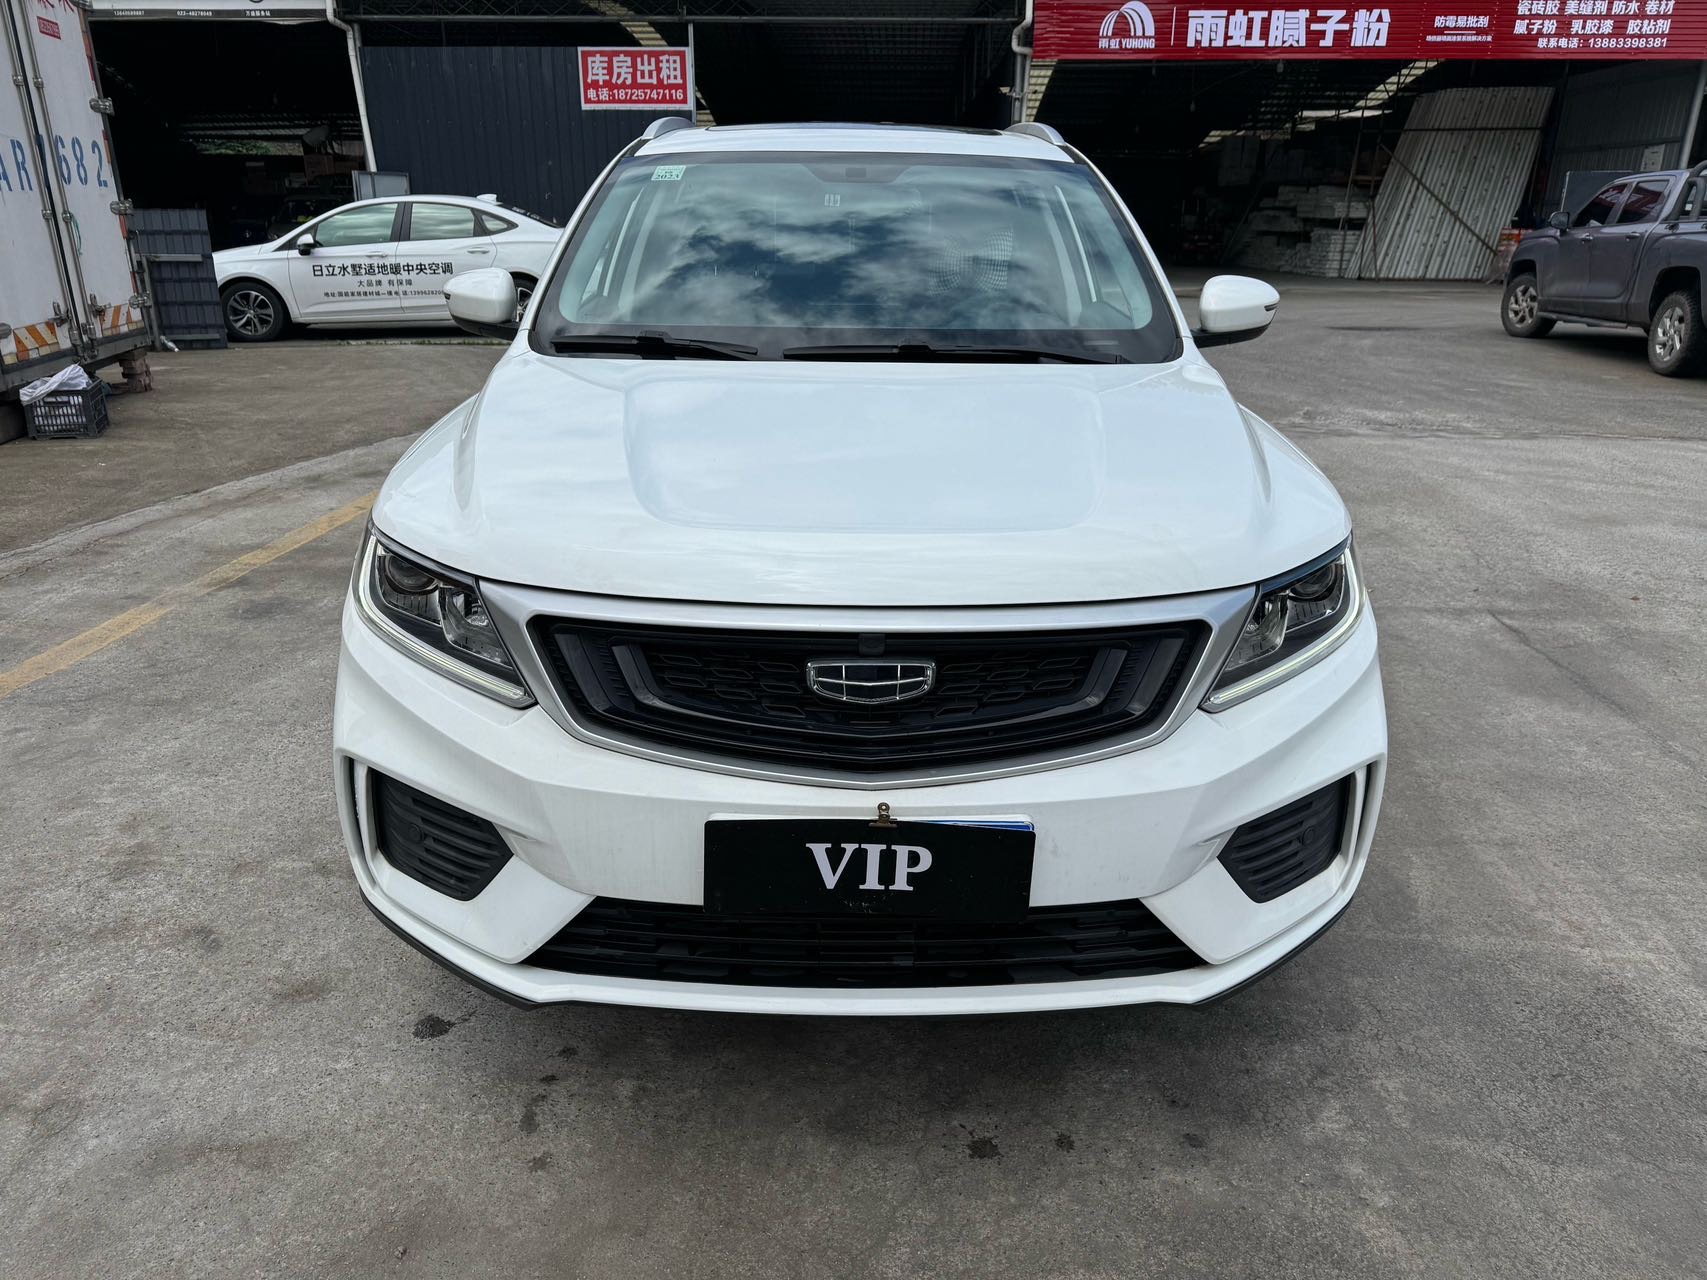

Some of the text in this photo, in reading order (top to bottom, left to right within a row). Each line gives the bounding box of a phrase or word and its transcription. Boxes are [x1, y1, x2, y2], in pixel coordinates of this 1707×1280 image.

[1517, 0, 1675, 15] 瓷砖胶 美缝剂 防水 卷材
[1186, 8, 1391, 47] 雨虹腻子粉
[1513, 19, 1671, 35] 腻子粉 乳胶漆 胶粘剂
[1099, 38, 1155, 49] 雨虹 YUHONG
[587, 54, 683, 85] 库房出租
[587, 88, 683, 101] 电话:18725747116
[312, 262, 453, 277] 日立水墅适地暖中央空调
[806, 843, 933, 891] VIP
